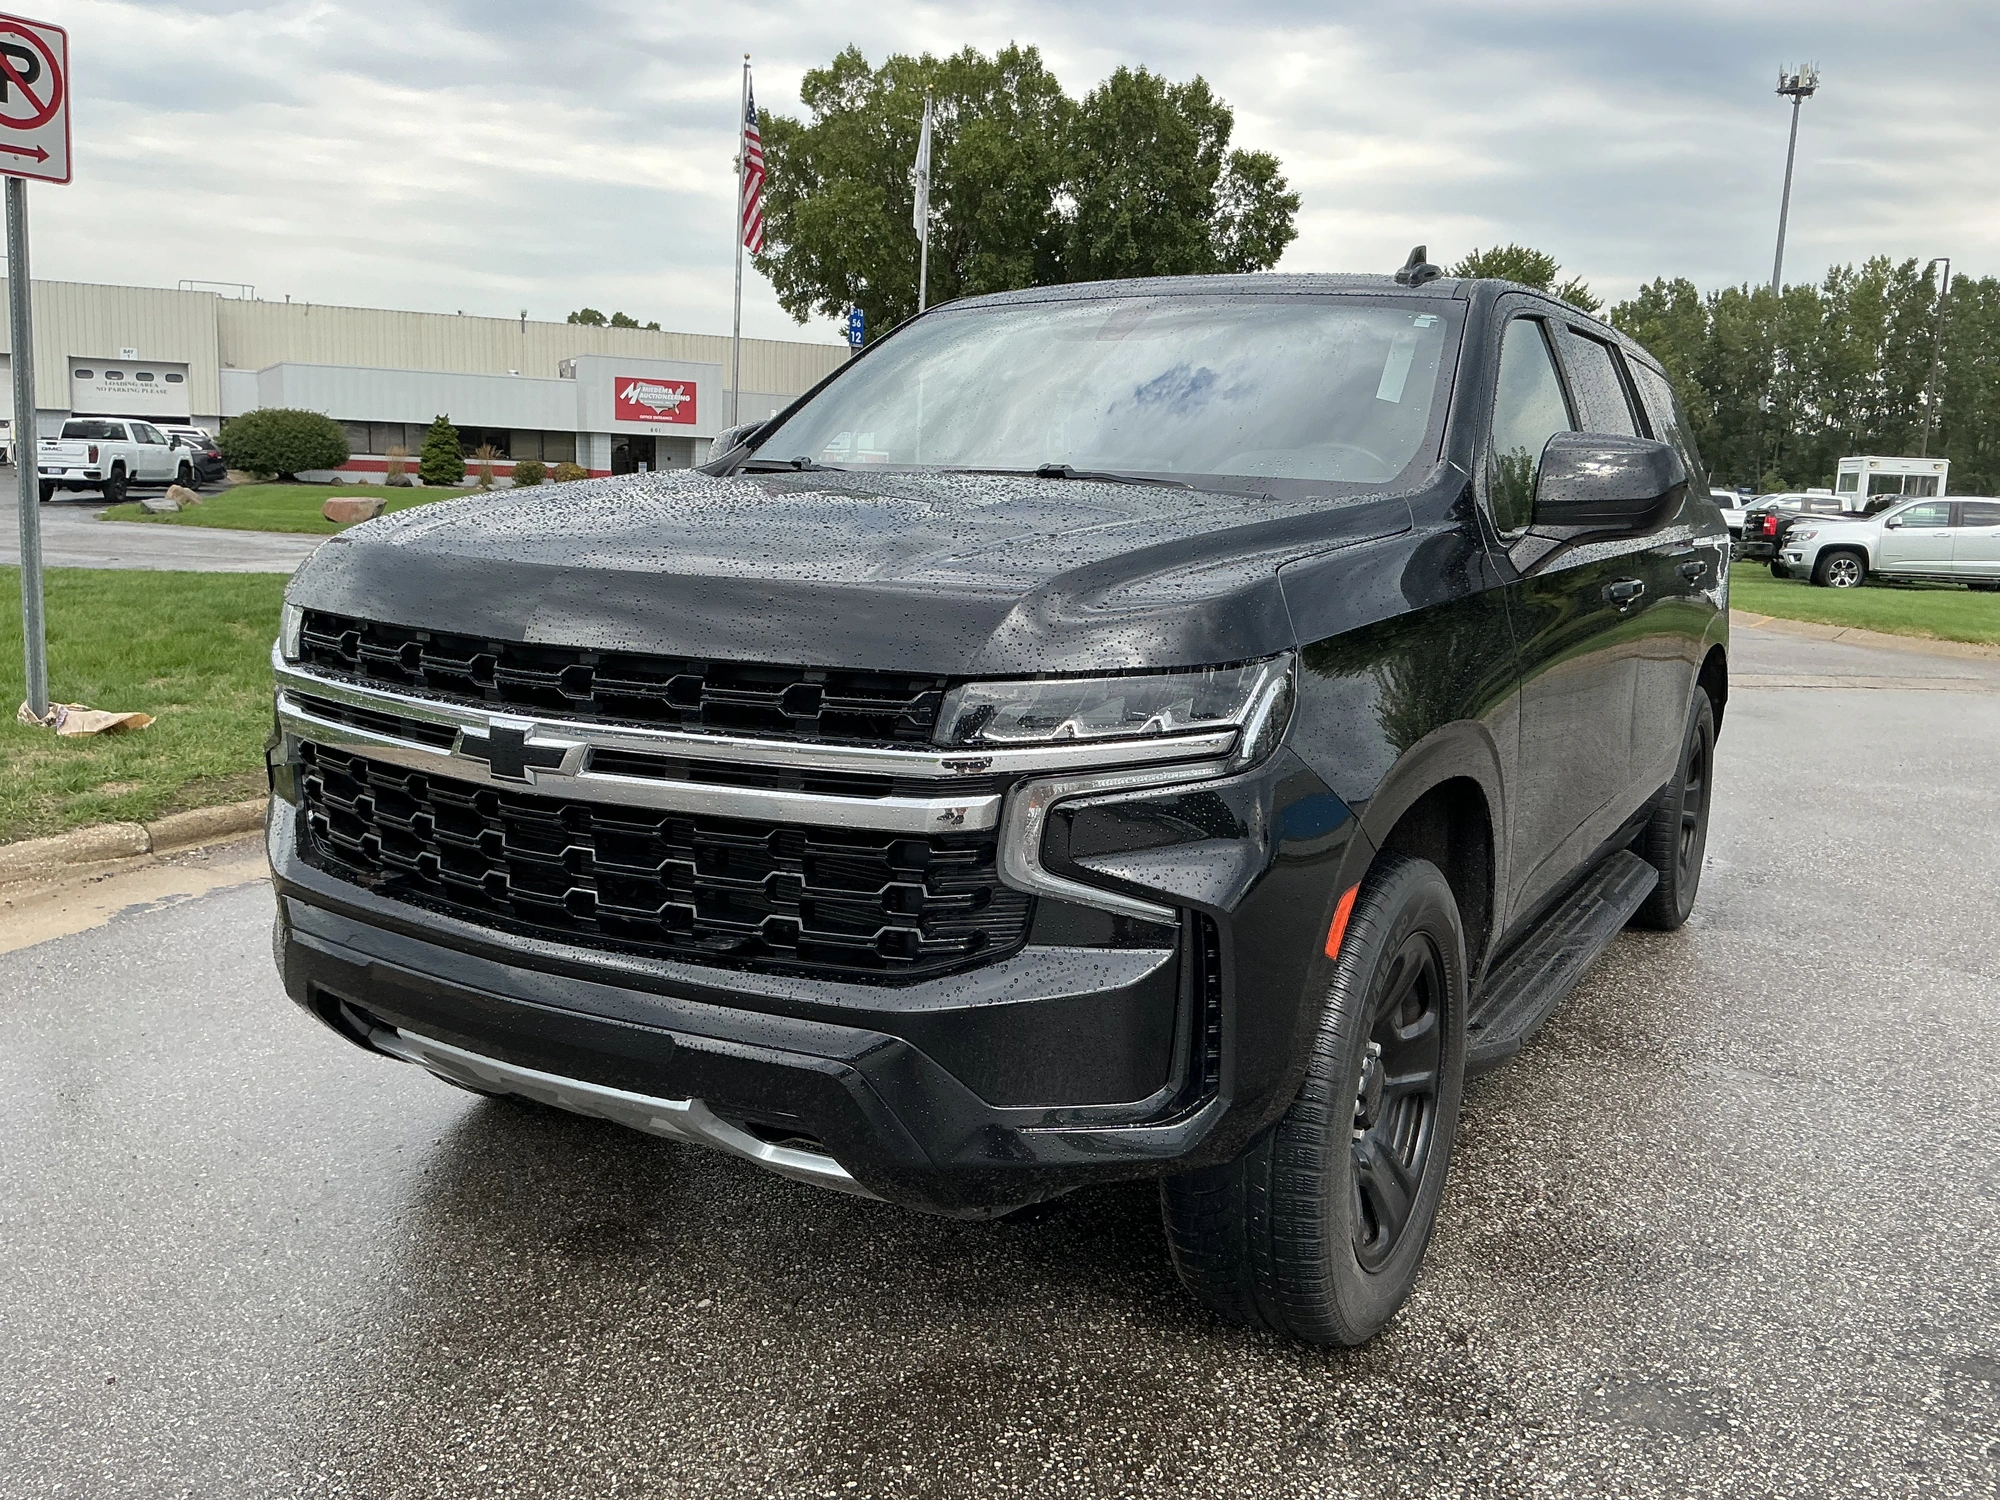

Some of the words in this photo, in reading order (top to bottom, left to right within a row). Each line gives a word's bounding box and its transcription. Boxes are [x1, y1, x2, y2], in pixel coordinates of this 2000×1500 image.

[0, 41, 41, 104] P
[852, 318, 861, 328] 56
[851, 331, 862, 343] 12
[639, 393, 691, 402] AUCTIONEERING
